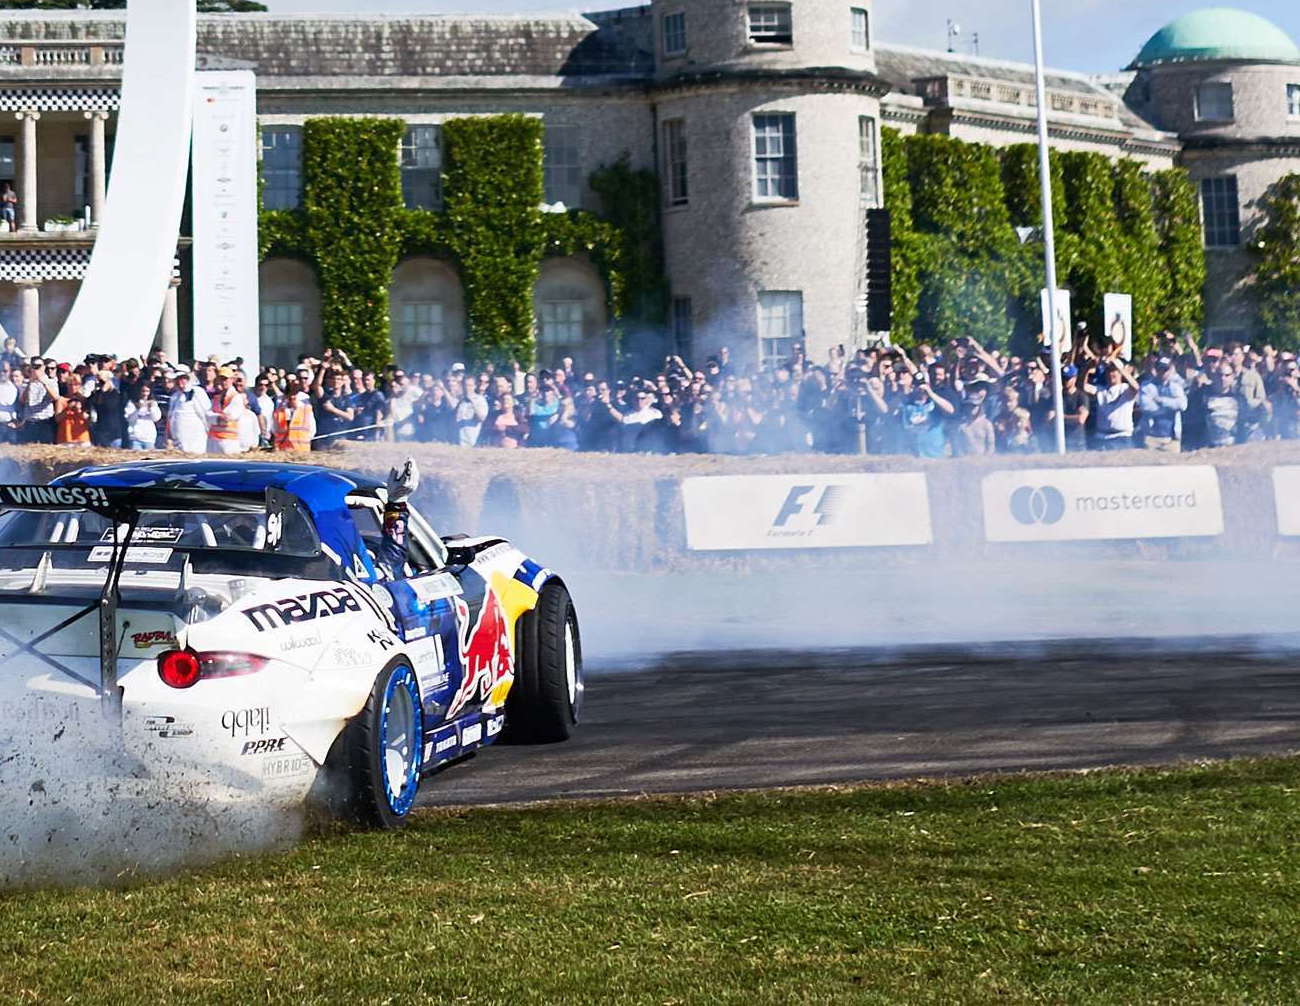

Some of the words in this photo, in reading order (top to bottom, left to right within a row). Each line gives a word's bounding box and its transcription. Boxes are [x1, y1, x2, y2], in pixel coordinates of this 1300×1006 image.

[7, 486, 110, 507] WINGS?!
[772, 485, 848, 526] F1
[1075, 490, 1197, 512] mastercard
[240, 587, 362, 632] mazda
